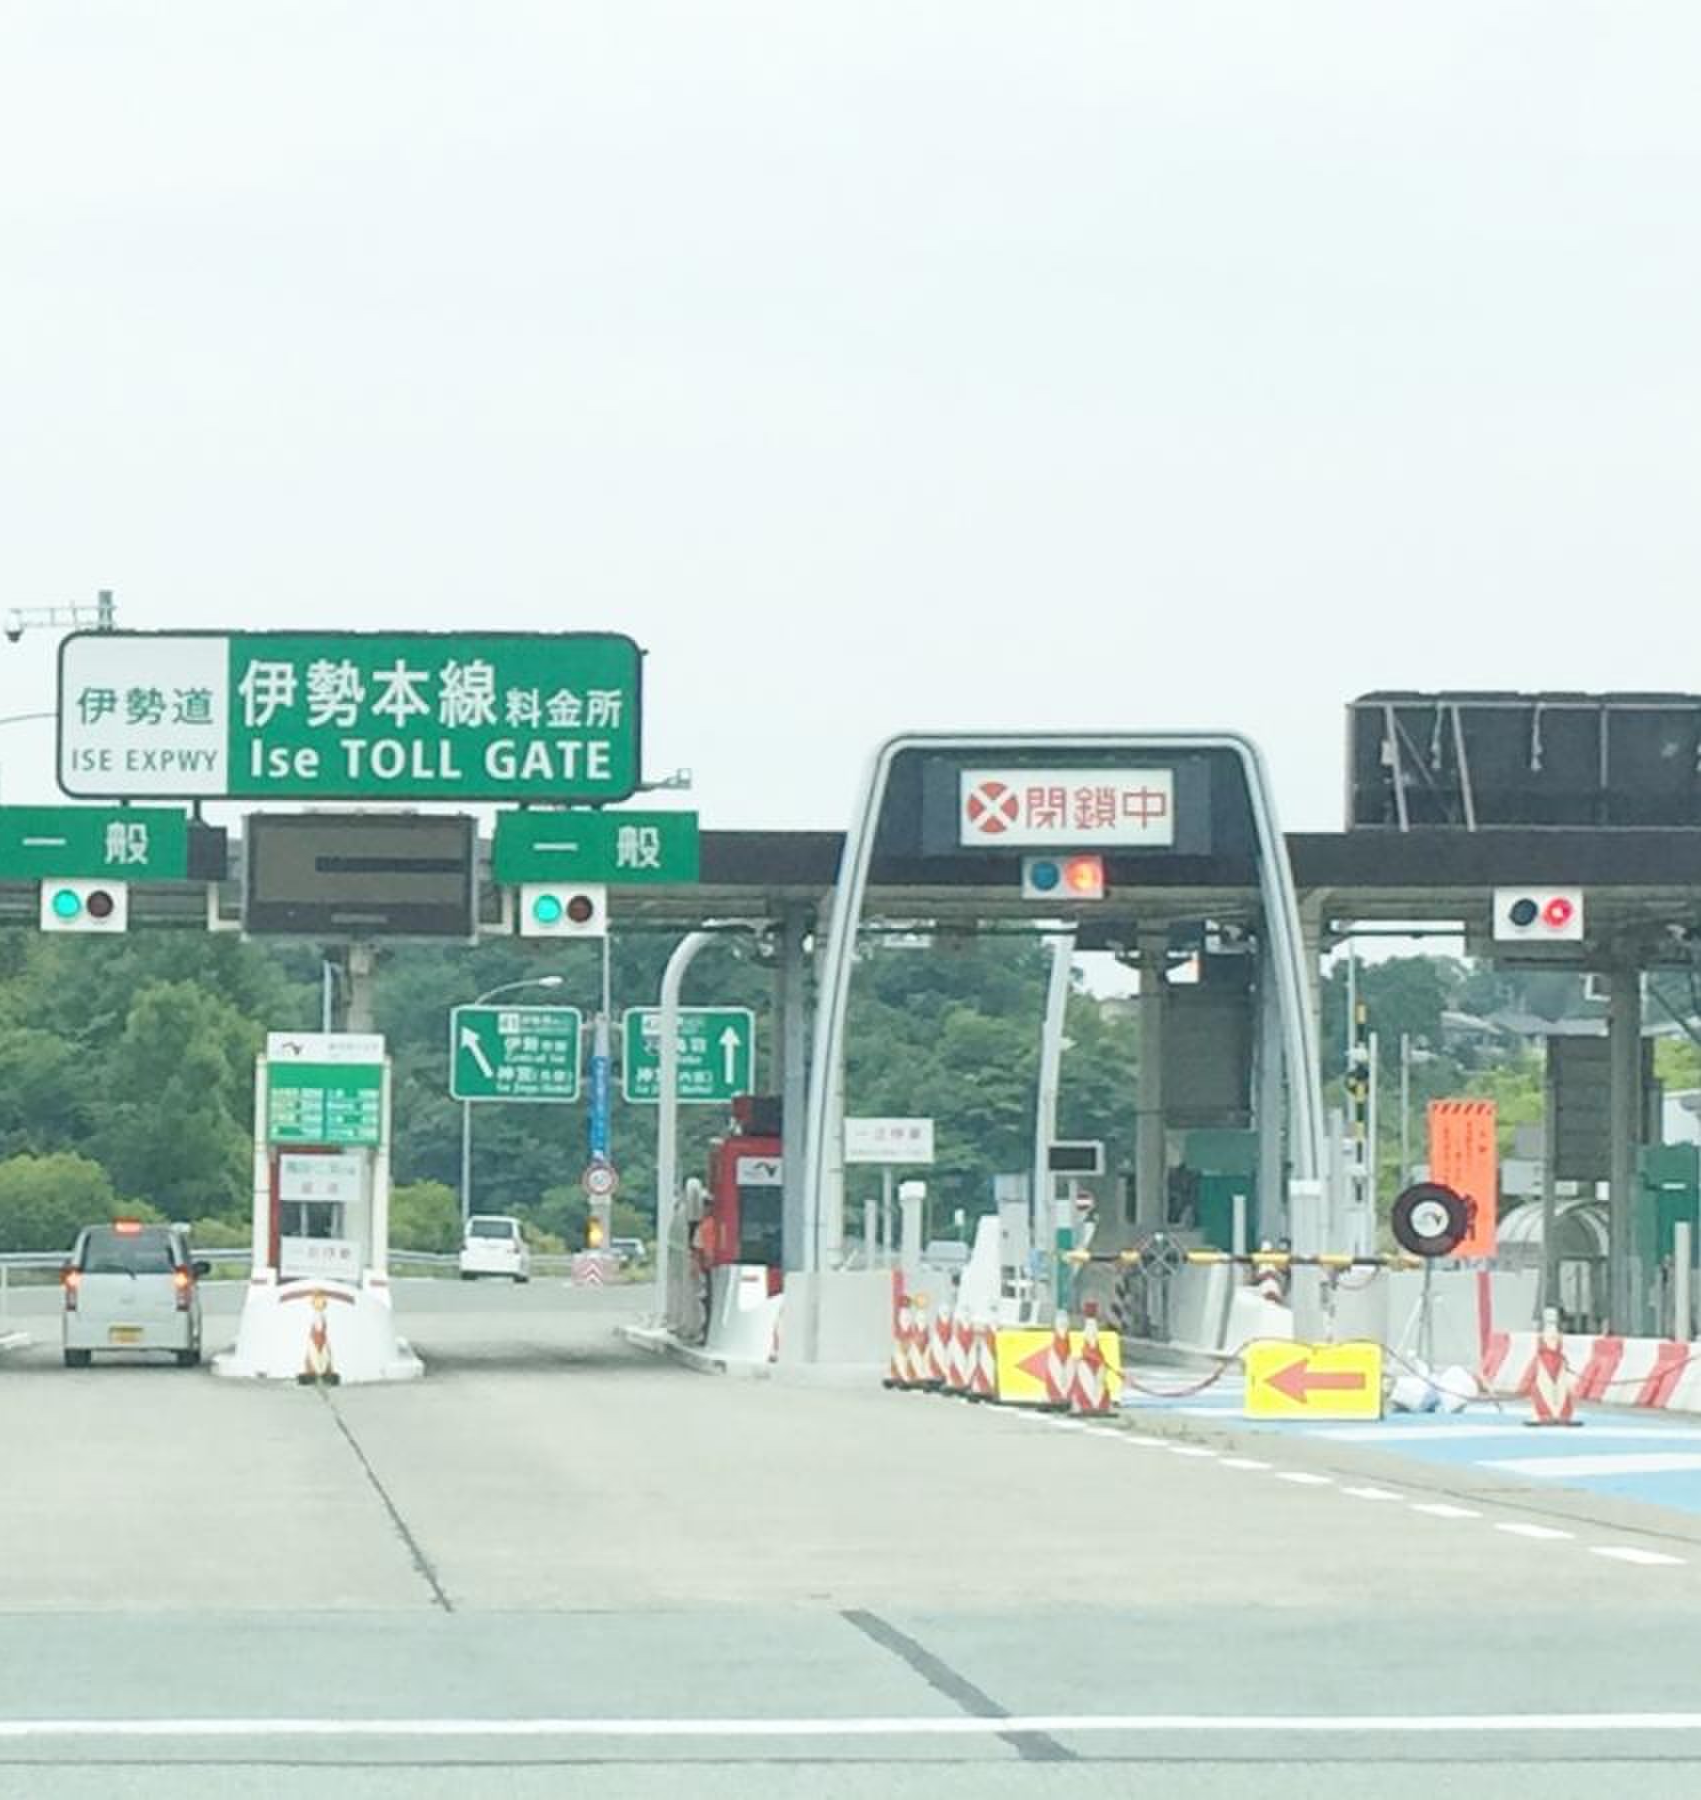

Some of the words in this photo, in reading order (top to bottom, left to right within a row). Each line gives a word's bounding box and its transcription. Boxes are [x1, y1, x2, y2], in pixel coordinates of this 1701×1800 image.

[76, 687, 213, 726] 伊勢道
[238, 658, 623, 728] 伊勢本線料金所
[72, 749, 112, 772] ISE
[126, 749, 218, 771] EXPWY
[251, 738, 319, 778] Ise
[340, 739, 462, 779] TOLL
[485, 739, 611, 779] GATE
[1025, 785, 1168, 831] 閉鎖中
[23, 821, 148, 865] 一般
[534, 825, 661, 868] 一般
